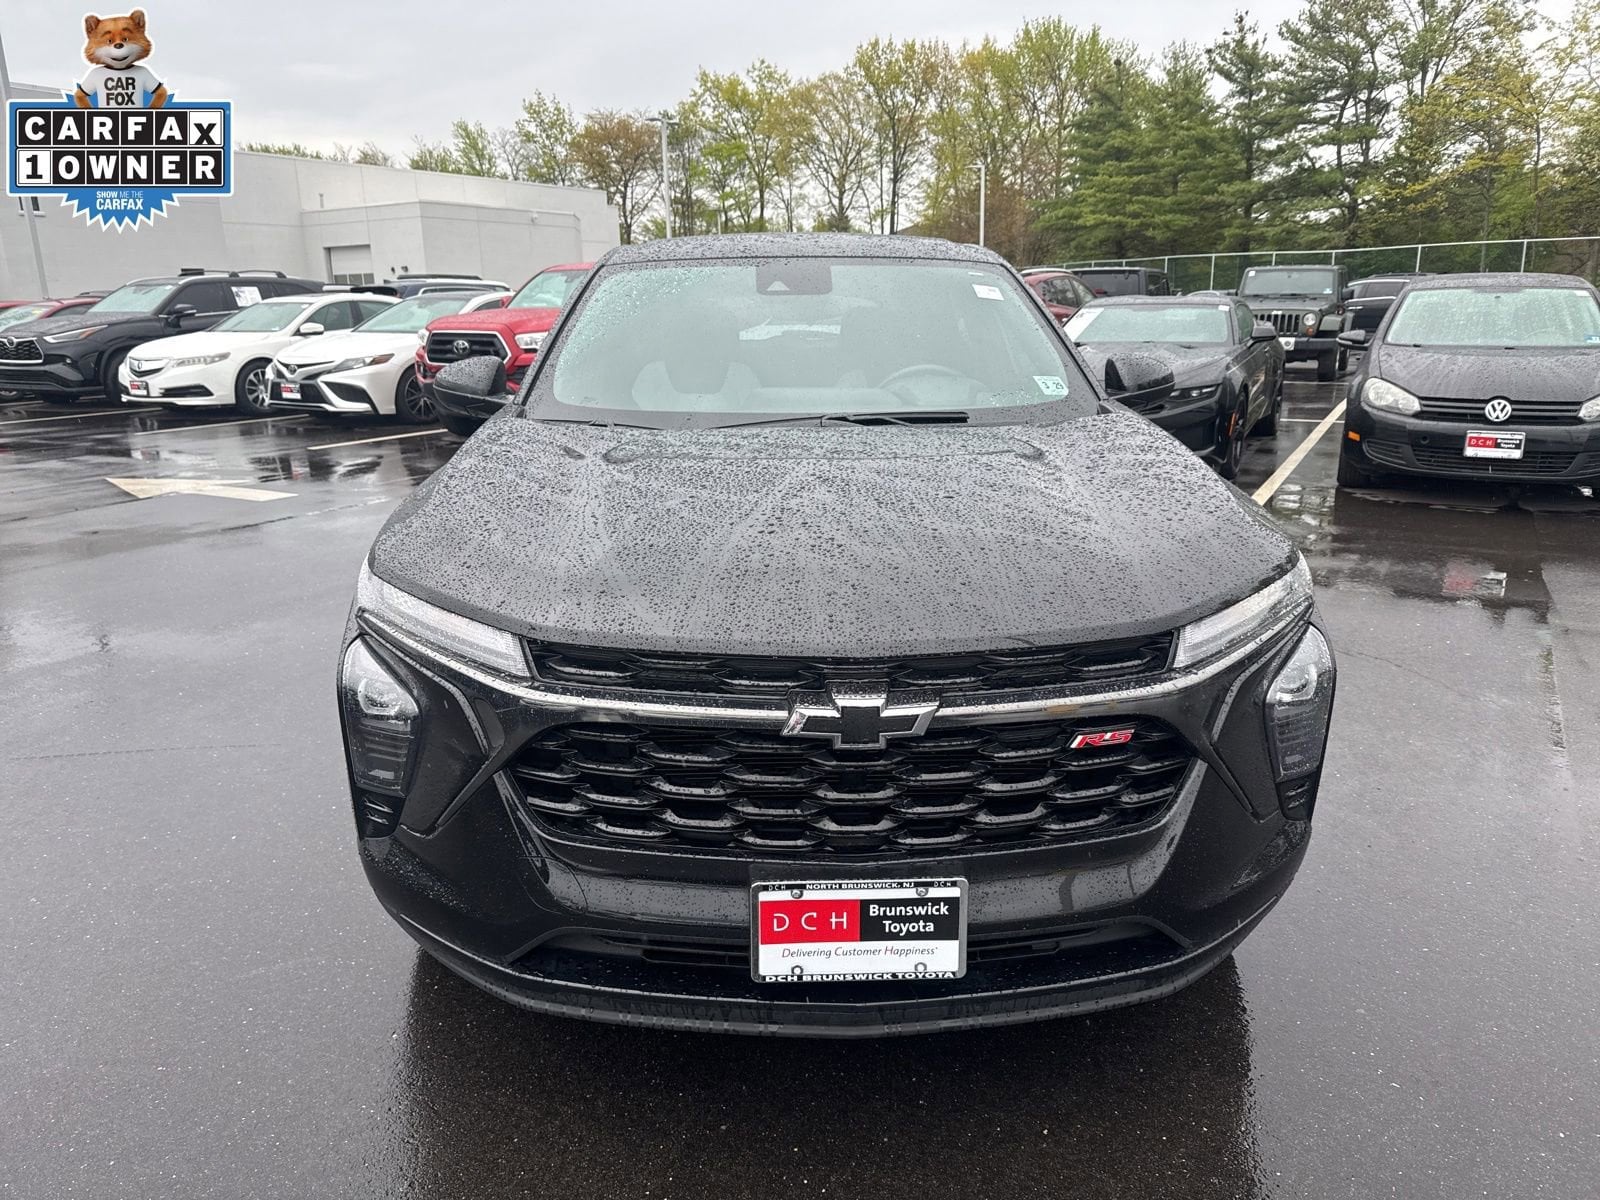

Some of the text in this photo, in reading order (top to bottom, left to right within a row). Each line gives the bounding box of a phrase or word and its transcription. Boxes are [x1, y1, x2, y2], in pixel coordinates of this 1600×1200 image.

[1070, 729, 1135, 749] RS
[841, 881, 901, 890] BRUNSWICK,
[869, 901, 950, 917] Brunswick
[882, 919, 935, 937] Toyota
[781, 947, 832, 959] Delivering
[834, 945, 882, 957] Customer
[802, 973, 893, 982] BRUNSWICK
[896, 971, 955, 979] TOYOTA
